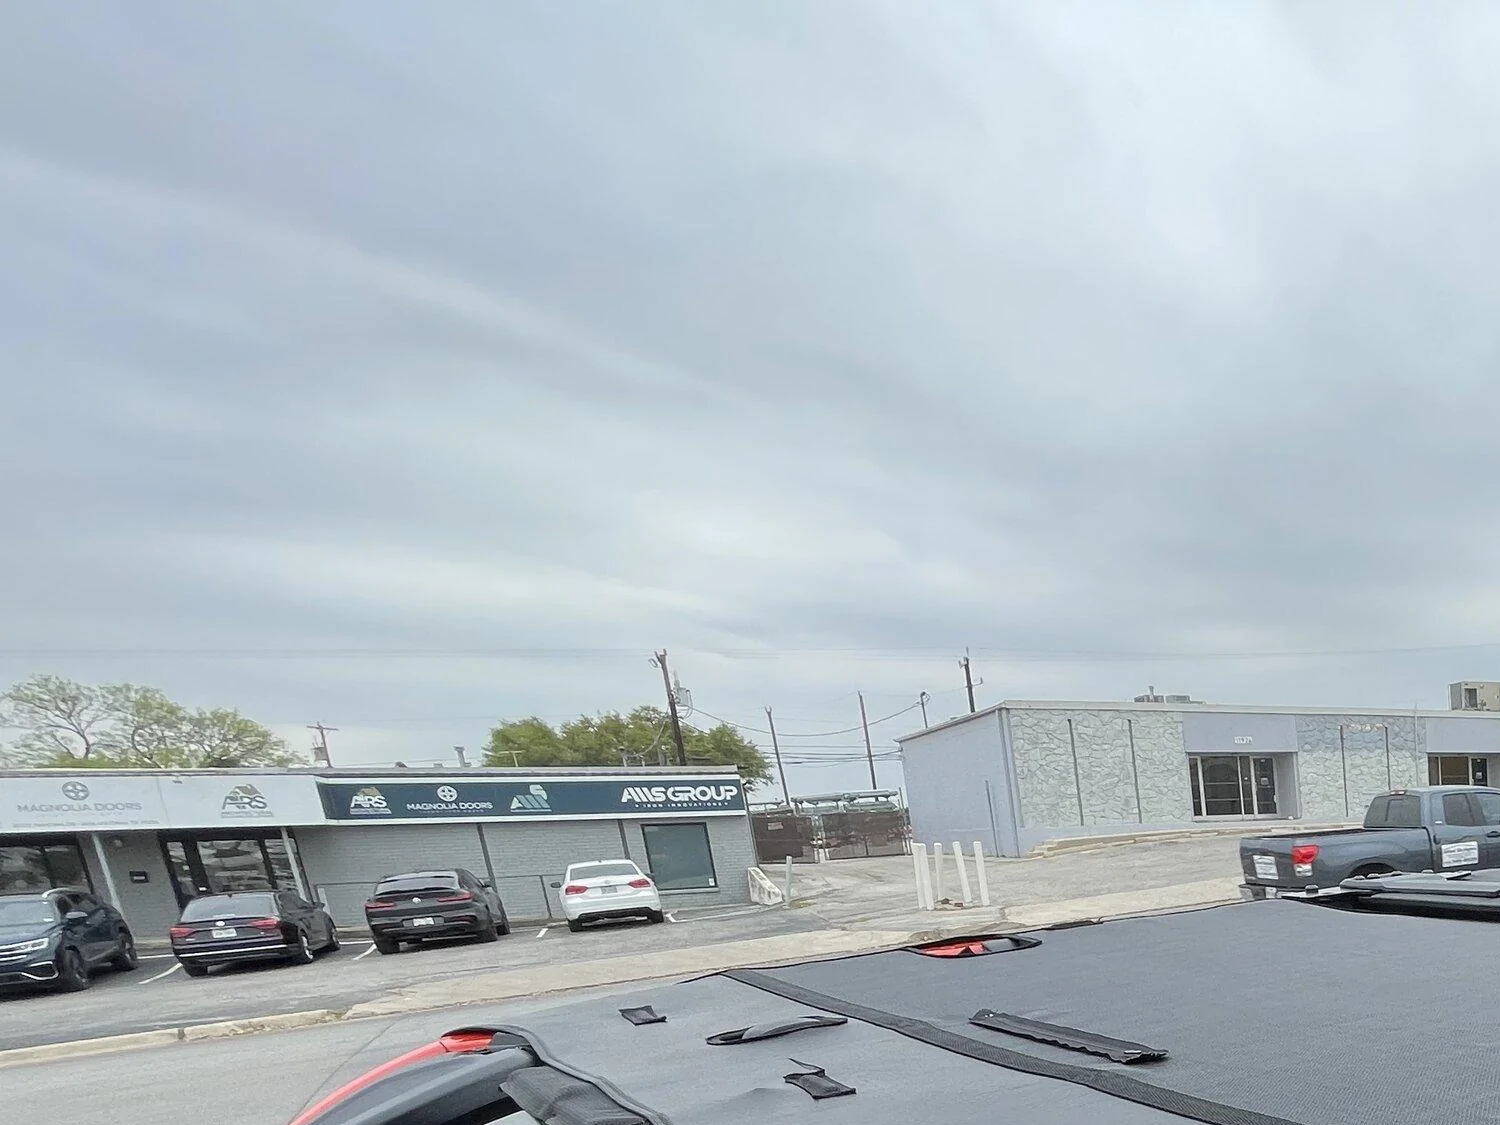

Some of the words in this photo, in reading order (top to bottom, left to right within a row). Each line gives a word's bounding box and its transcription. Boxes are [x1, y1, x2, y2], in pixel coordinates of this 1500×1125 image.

[666, 785, 738, 802] GROUP
[17, 803, 91, 812] MAGNOLIA
[93, 802, 143, 811] DOORS
[406, 802, 459, 810] MAGNOLIA
